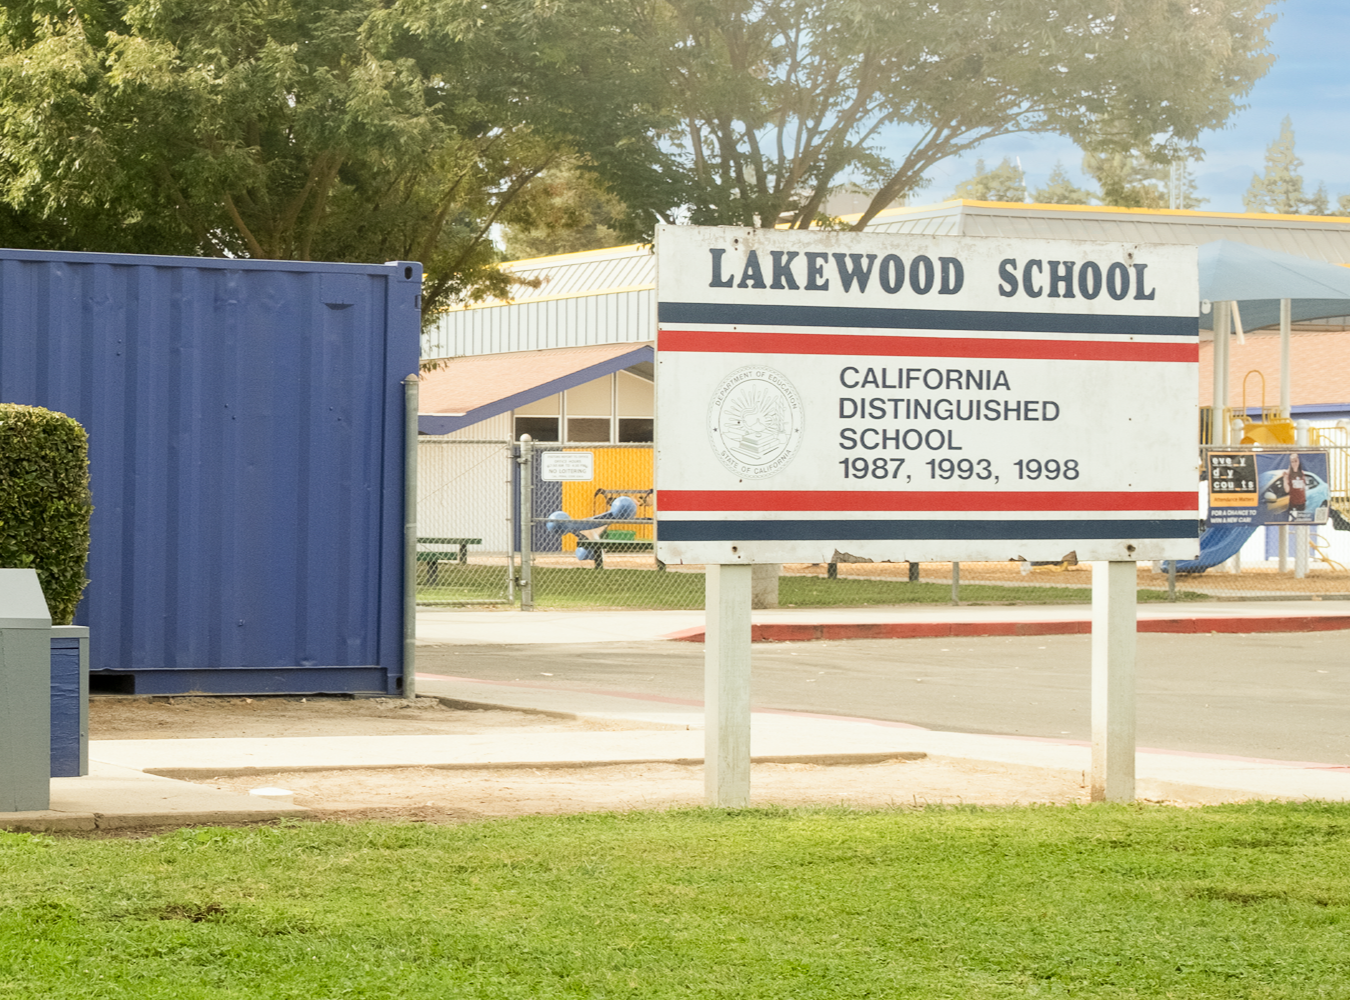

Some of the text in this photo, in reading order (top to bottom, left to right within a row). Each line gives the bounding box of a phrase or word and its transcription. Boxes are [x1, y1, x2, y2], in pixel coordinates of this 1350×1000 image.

[708, 247, 1156, 301] LAKEWOOD SCHOOL
[714, 371, 752, 406] DEPARTMENT
[768, 374, 798, 409] EDUCATION
[839, 366, 1011, 391] CALIFORNIA
[839, 397, 1060, 422] DISTINGUISHED
[839, 427, 963, 451] SCHOOL
[721, 450, 739, 469] STATE
[753, 449, 792, 475] CALIFORNIA
[838, 457, 1080, 484] 1987, 1993, 1998
